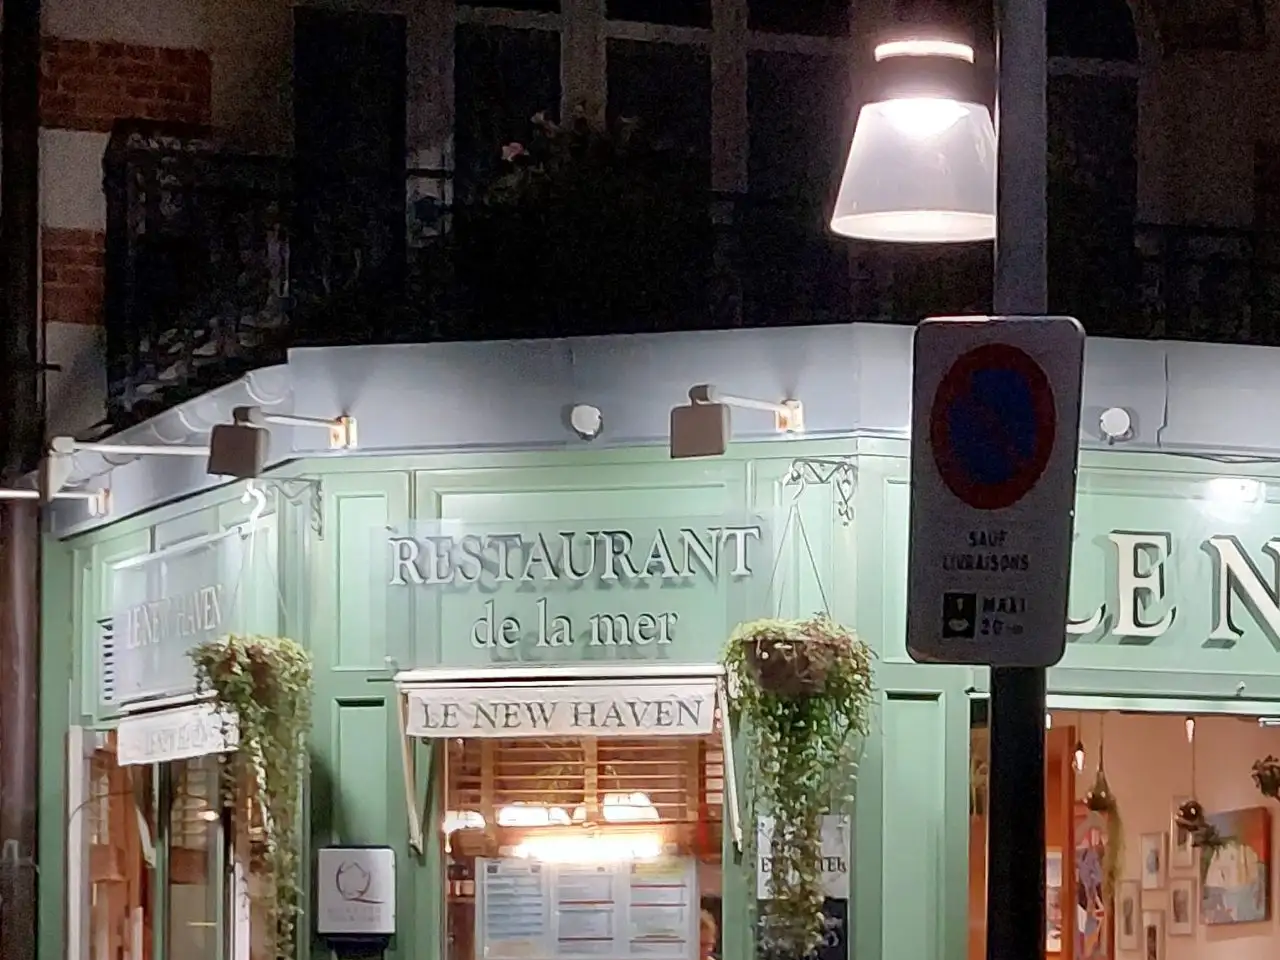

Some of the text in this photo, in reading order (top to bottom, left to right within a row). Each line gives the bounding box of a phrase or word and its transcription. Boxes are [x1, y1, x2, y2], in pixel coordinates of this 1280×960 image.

[388, 526, 761, 586] RESTAURANT
[968, 530, 1007, 547] SAUF
[942, 553, 1029, 572] LIVRAISONS
[1066, 529, 1177, 642] E
[470, 597, 680, 649] de la mer
[421, 699, 703, 730] LE NEW HAVEN
